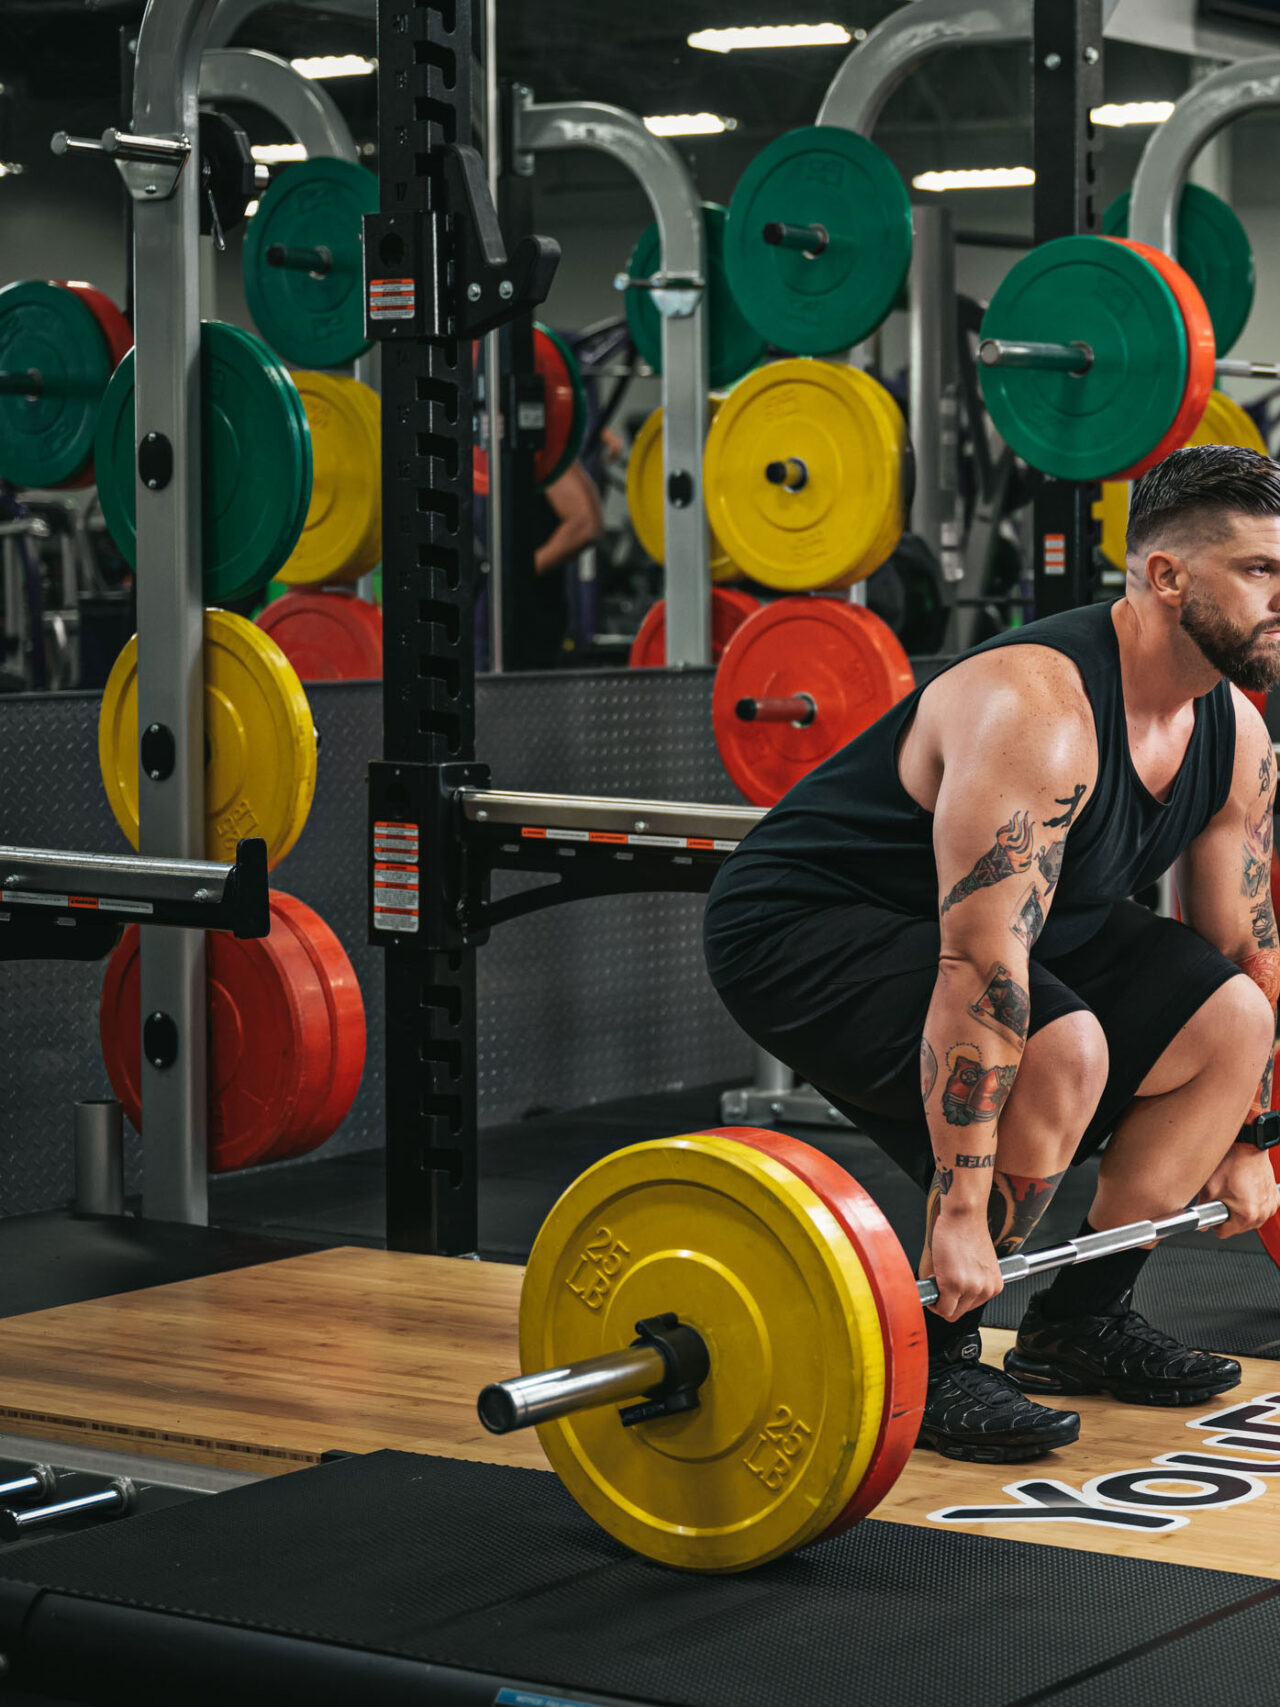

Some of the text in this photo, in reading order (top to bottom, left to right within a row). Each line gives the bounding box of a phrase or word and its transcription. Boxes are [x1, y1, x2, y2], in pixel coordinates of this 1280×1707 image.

[585, 1226, 631, 1275] 25
[565, 1252, 611, 1310] LB
[765, 1405, 812, 1456] 25
[743, 1432, 792, 1490] LB
